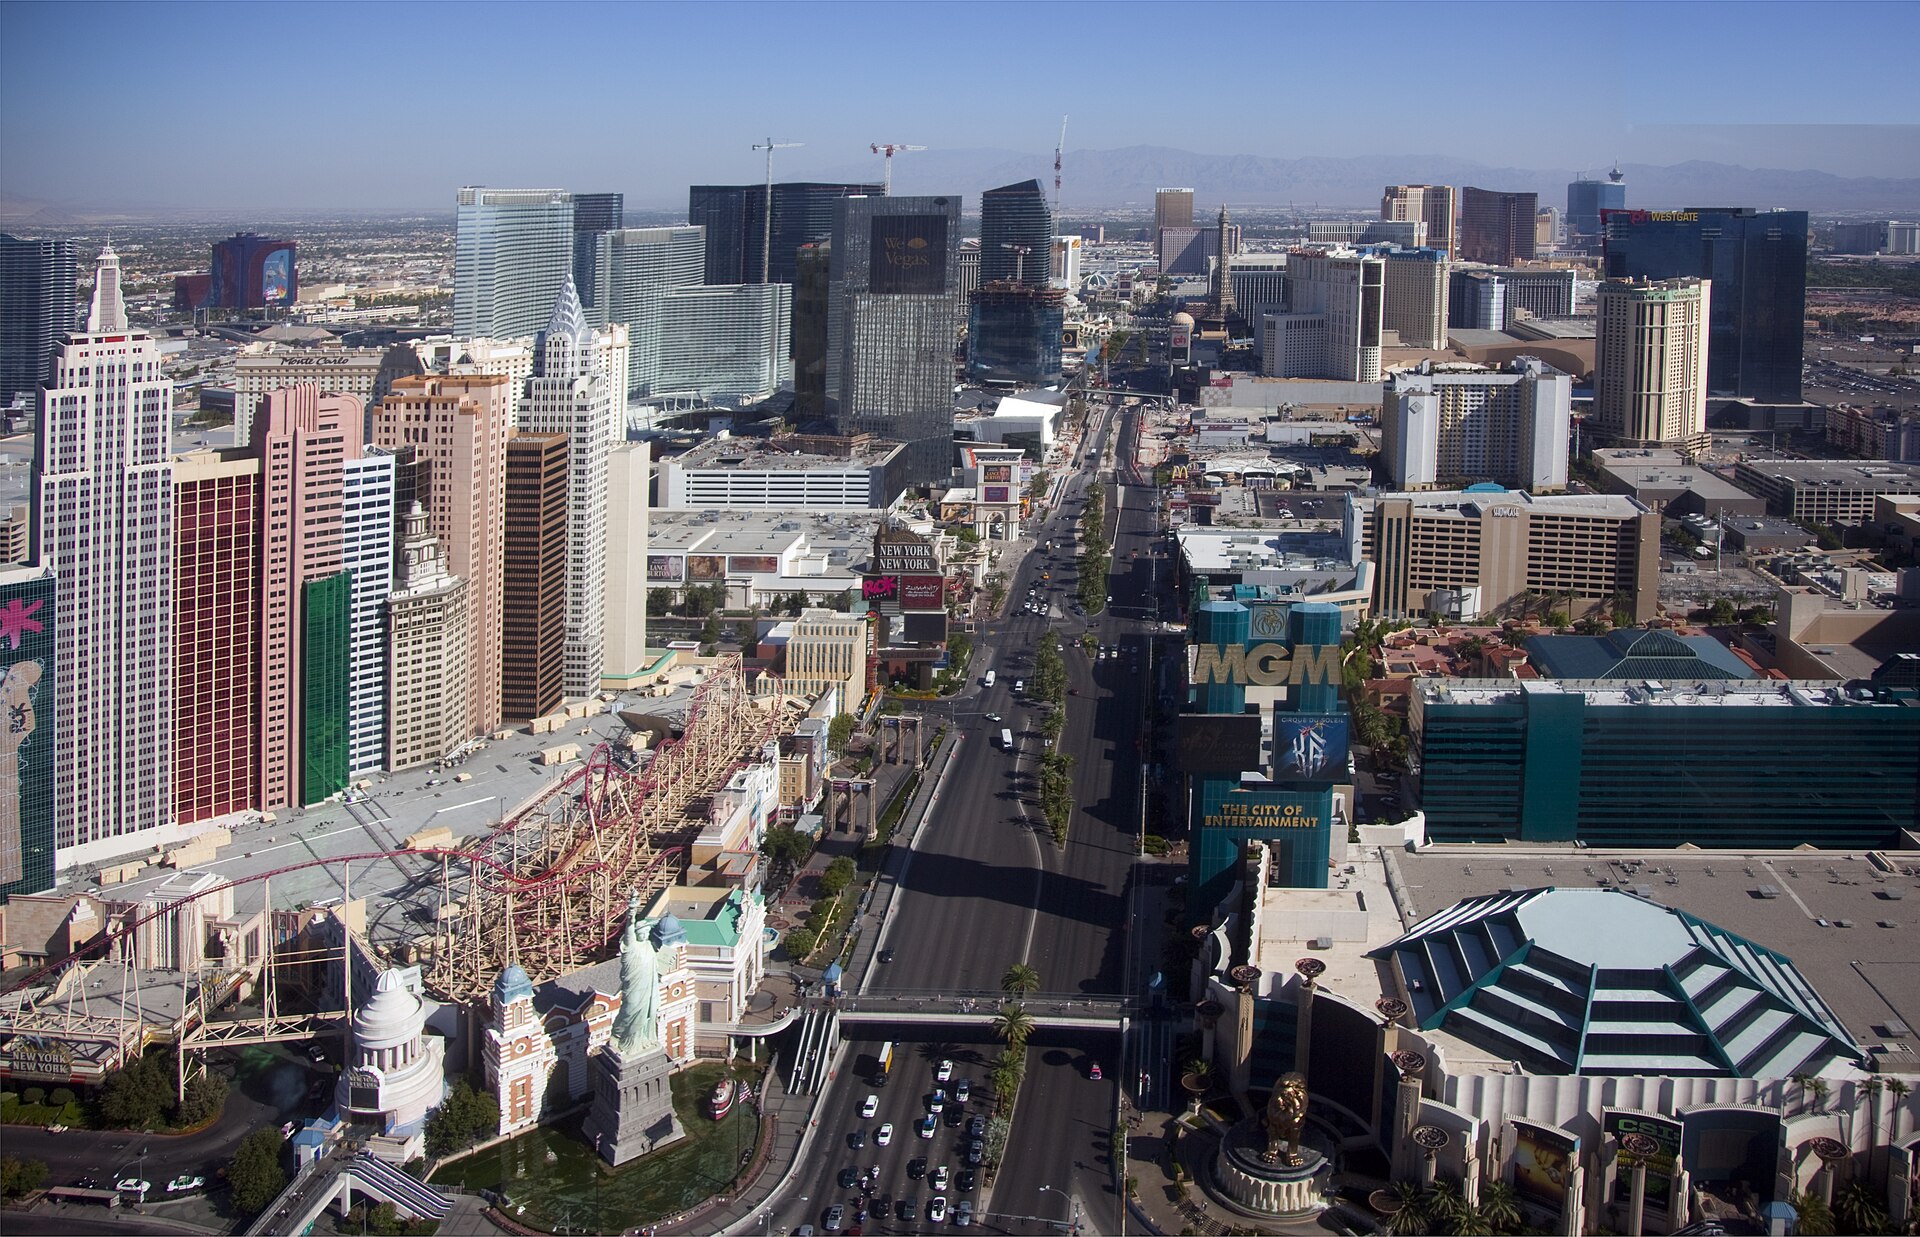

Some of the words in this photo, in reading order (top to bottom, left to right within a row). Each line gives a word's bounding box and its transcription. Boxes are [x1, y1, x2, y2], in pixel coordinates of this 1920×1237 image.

[1651, 211, 1698, 222] WESTGATE
[885, 237, 904, 249] We
[280, 357, 315, 365] Monte
[316, 357, 349, 365] Carlo
[880, 545, 902, 556] NEW
[904, 545, 931, 556] YORK
[880, 559, 902, 570] NEW
[904, 559, 930, 570] YORK
[1193, 643, 1342, 686] MGM
[1222, 804, 1248, 815] THE
[1252, 804, 1281, 815] CITY
[1284, 805, 1304, 816] OF
[1205, 815, 1319, 828] ENTERTAINMENT
[13, 1051, 36, 1061] NEW
[38, 1053, 67, 1063] YORK
[13, 1061, 36, 1071] NEW
[38, 1063, 67, 1073] YORK
